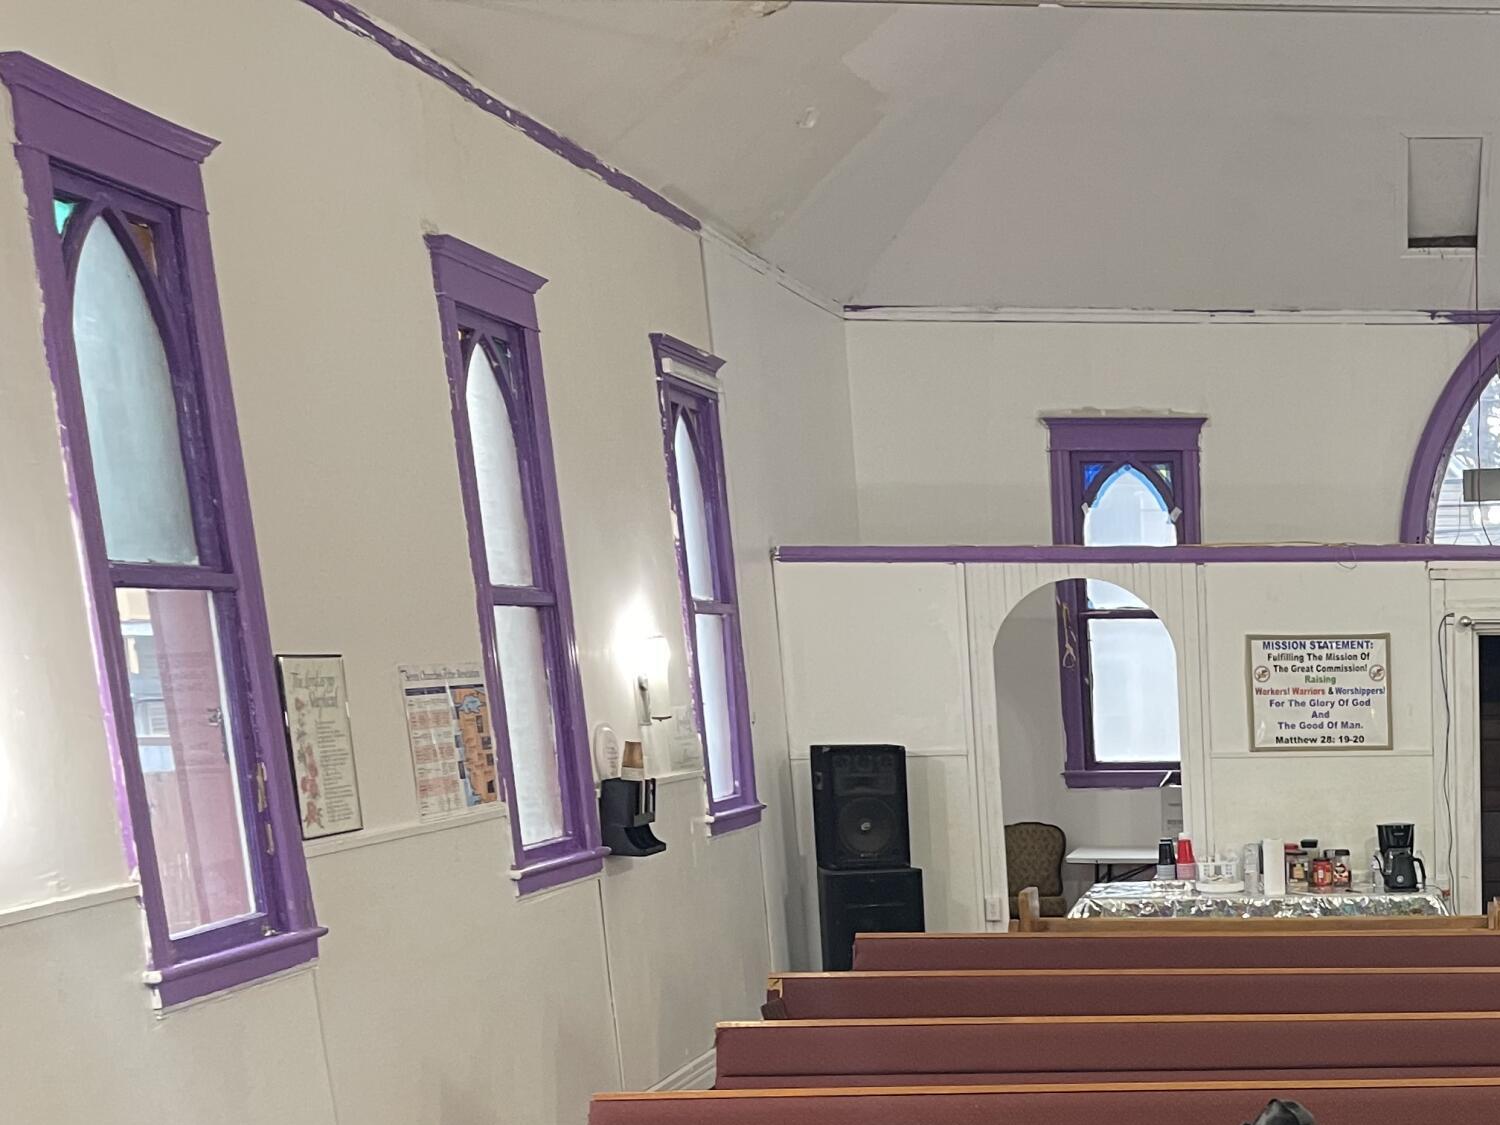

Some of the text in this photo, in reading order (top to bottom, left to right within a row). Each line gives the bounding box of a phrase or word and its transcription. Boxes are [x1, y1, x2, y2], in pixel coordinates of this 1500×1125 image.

[1262, 640, 1374, 650] MISSION STATEMENT:
[1267, 652, 1370, 663] Fulfilling The Mission Of
[1273, 664, 1368, 673] The Great Commission!
[1304, 675, 1337, 685] Raising
[1291, 687, 1326, 696] Warriors
[1327, 687, 1334, 695] &
[1335, 687, 1386, 697] Worshippers!
[1269, 698, 1371, 709] For The Glory Of God
[1311, 710, 1330, 719] And
[1278, 721, 1364, 730] The Good Of Man.
[1275, 735, 1365, 744] Matthew 28: 19-20
